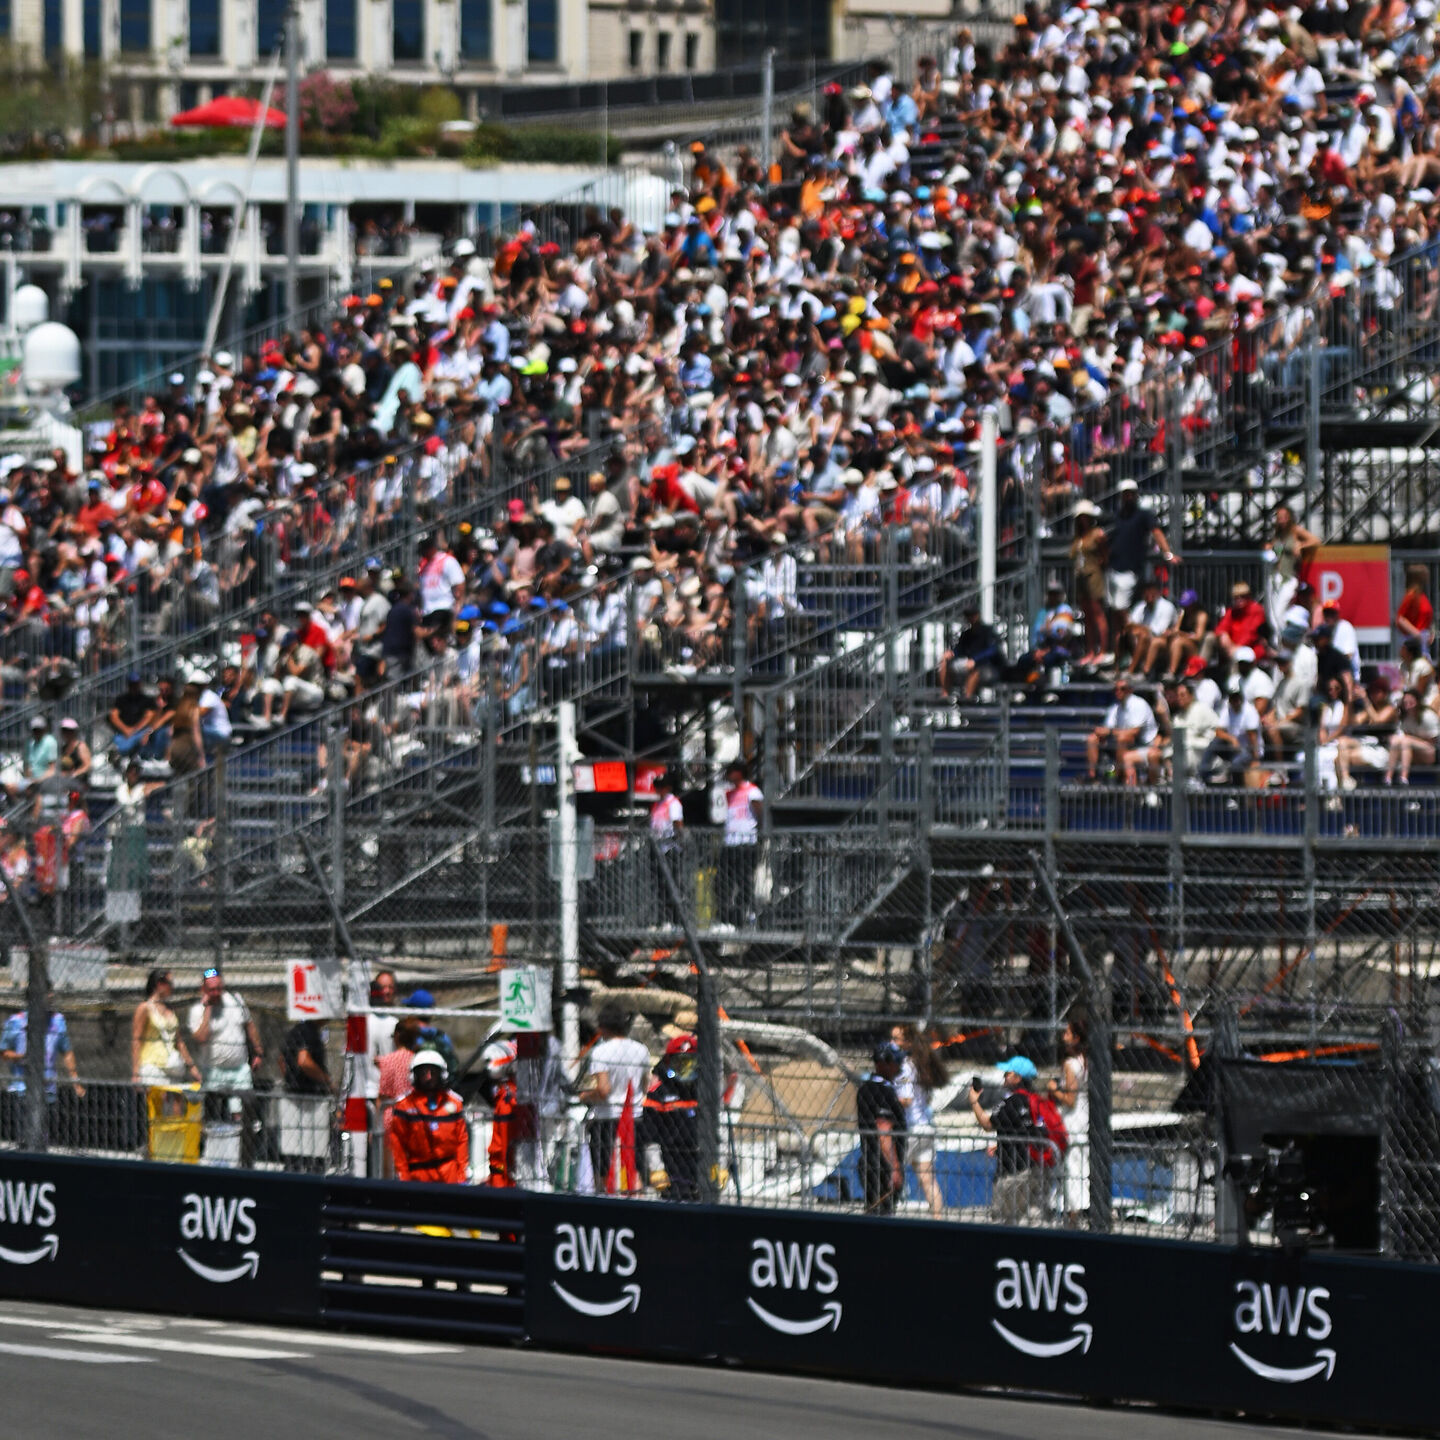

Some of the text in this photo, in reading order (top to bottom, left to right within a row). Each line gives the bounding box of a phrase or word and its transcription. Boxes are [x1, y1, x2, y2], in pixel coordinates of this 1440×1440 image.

[181, 1193, 257, 1244] aws
[554, 1223, 638, 1277] aws
[750, 1238, 839, 1294] aws
[995, 1257, 1089, 1316] aws
[1235, 1281, 1333, 1341] aws
